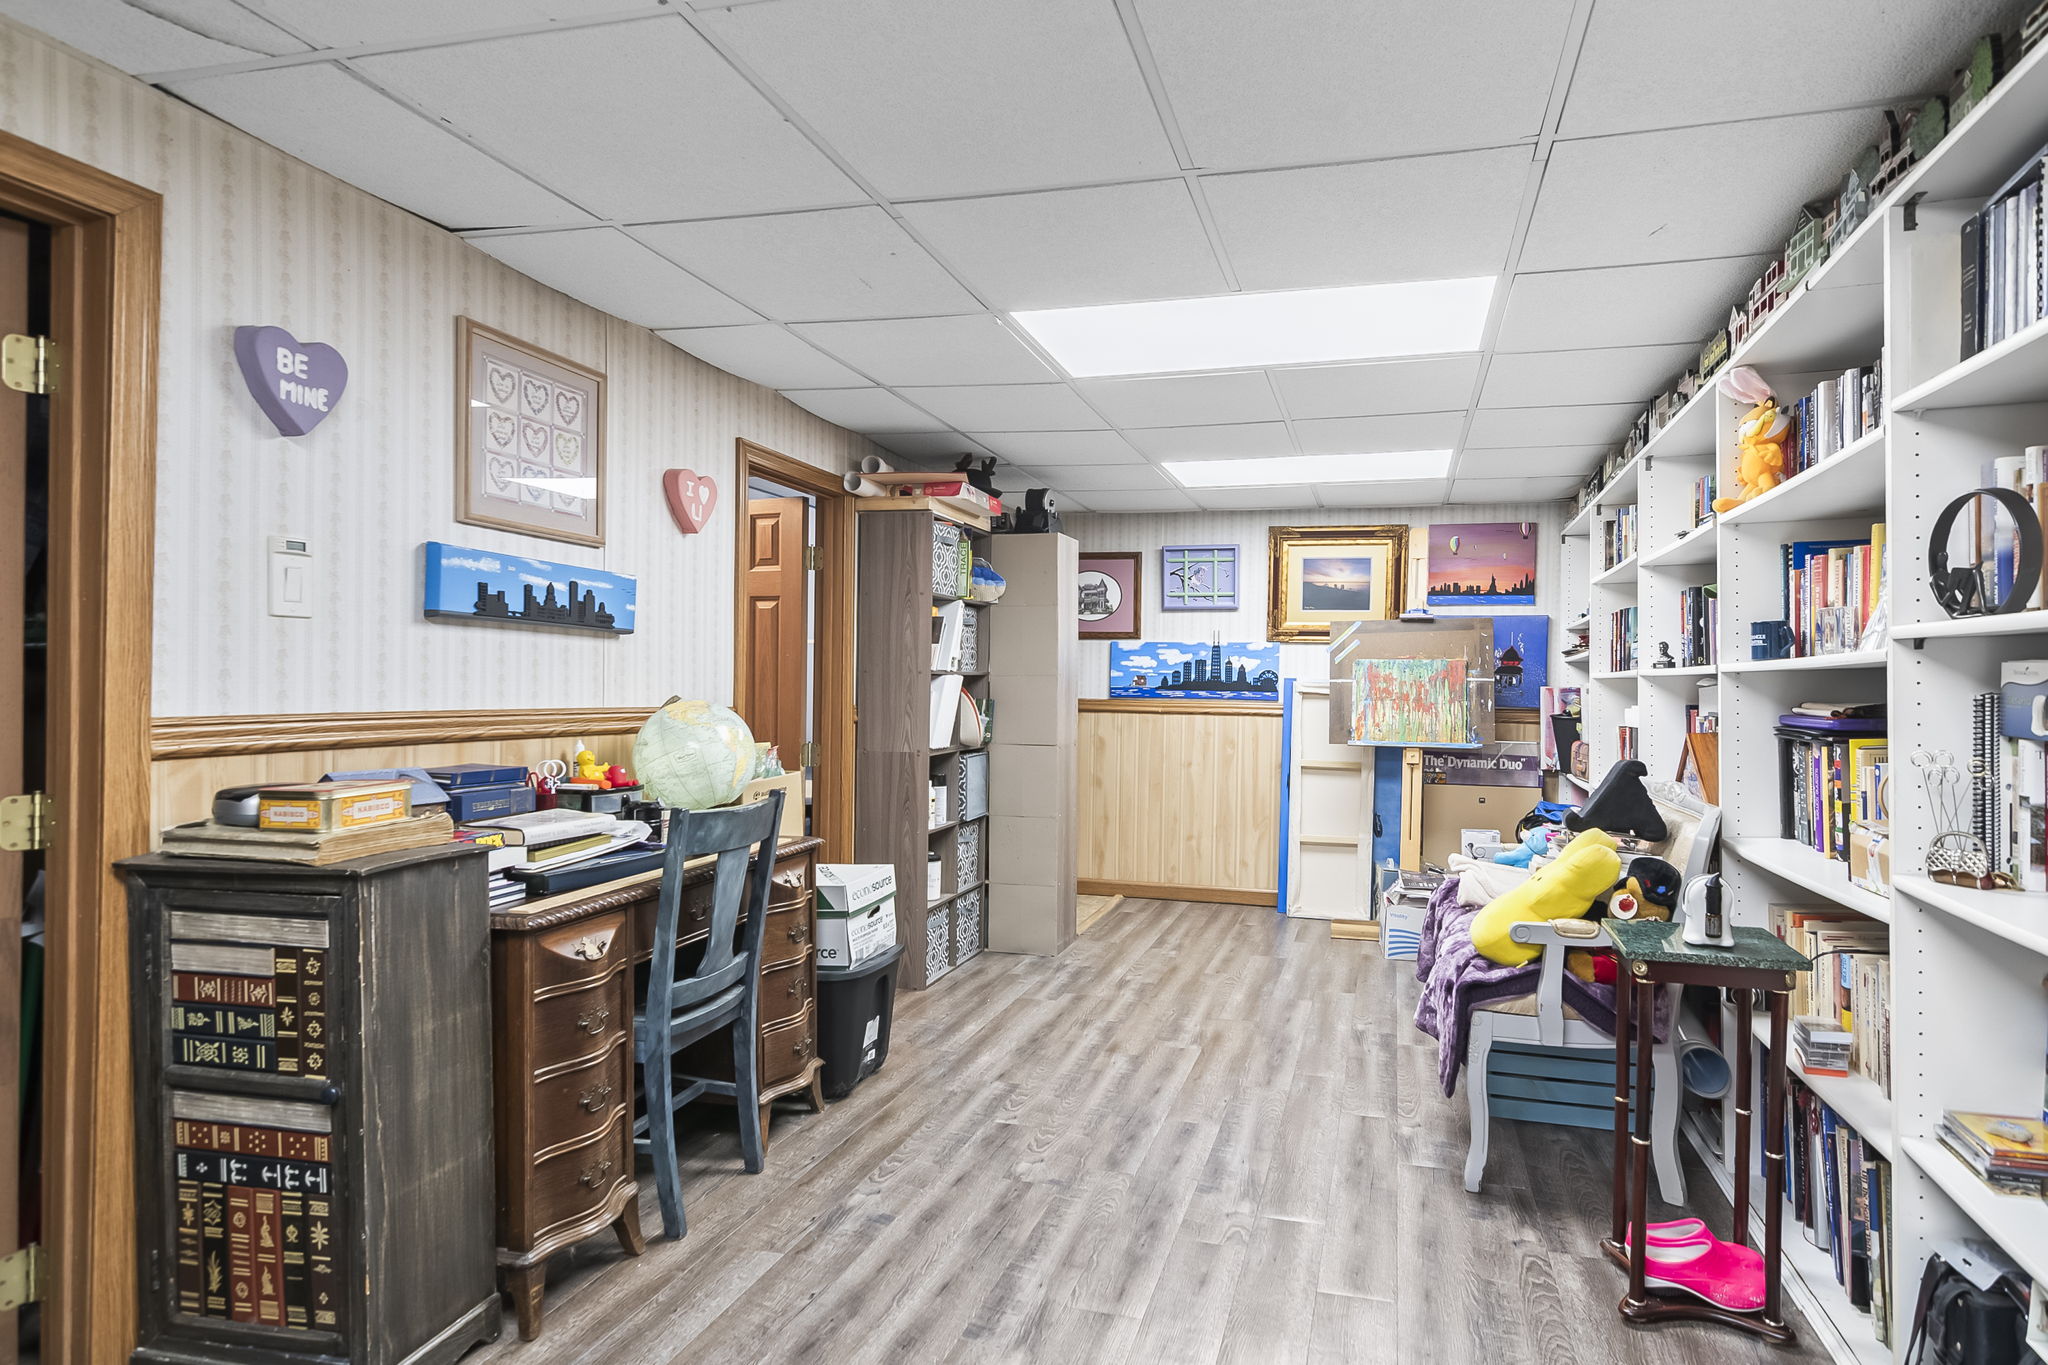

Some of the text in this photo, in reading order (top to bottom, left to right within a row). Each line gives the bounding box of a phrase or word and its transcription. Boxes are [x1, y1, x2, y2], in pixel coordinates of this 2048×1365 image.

[276, 346, 309, 380] BE
[279, 379, 329, 412] MINE
[686, 481, 695, 497] I
[691, 503, 703, 521] U
[1423, 755, 1445, 767] The
[1499, 758, 1526, 771] Duo"
[273, 810, 305, 818] NABISCO
[357, 802, 390, 814] NABISCO
